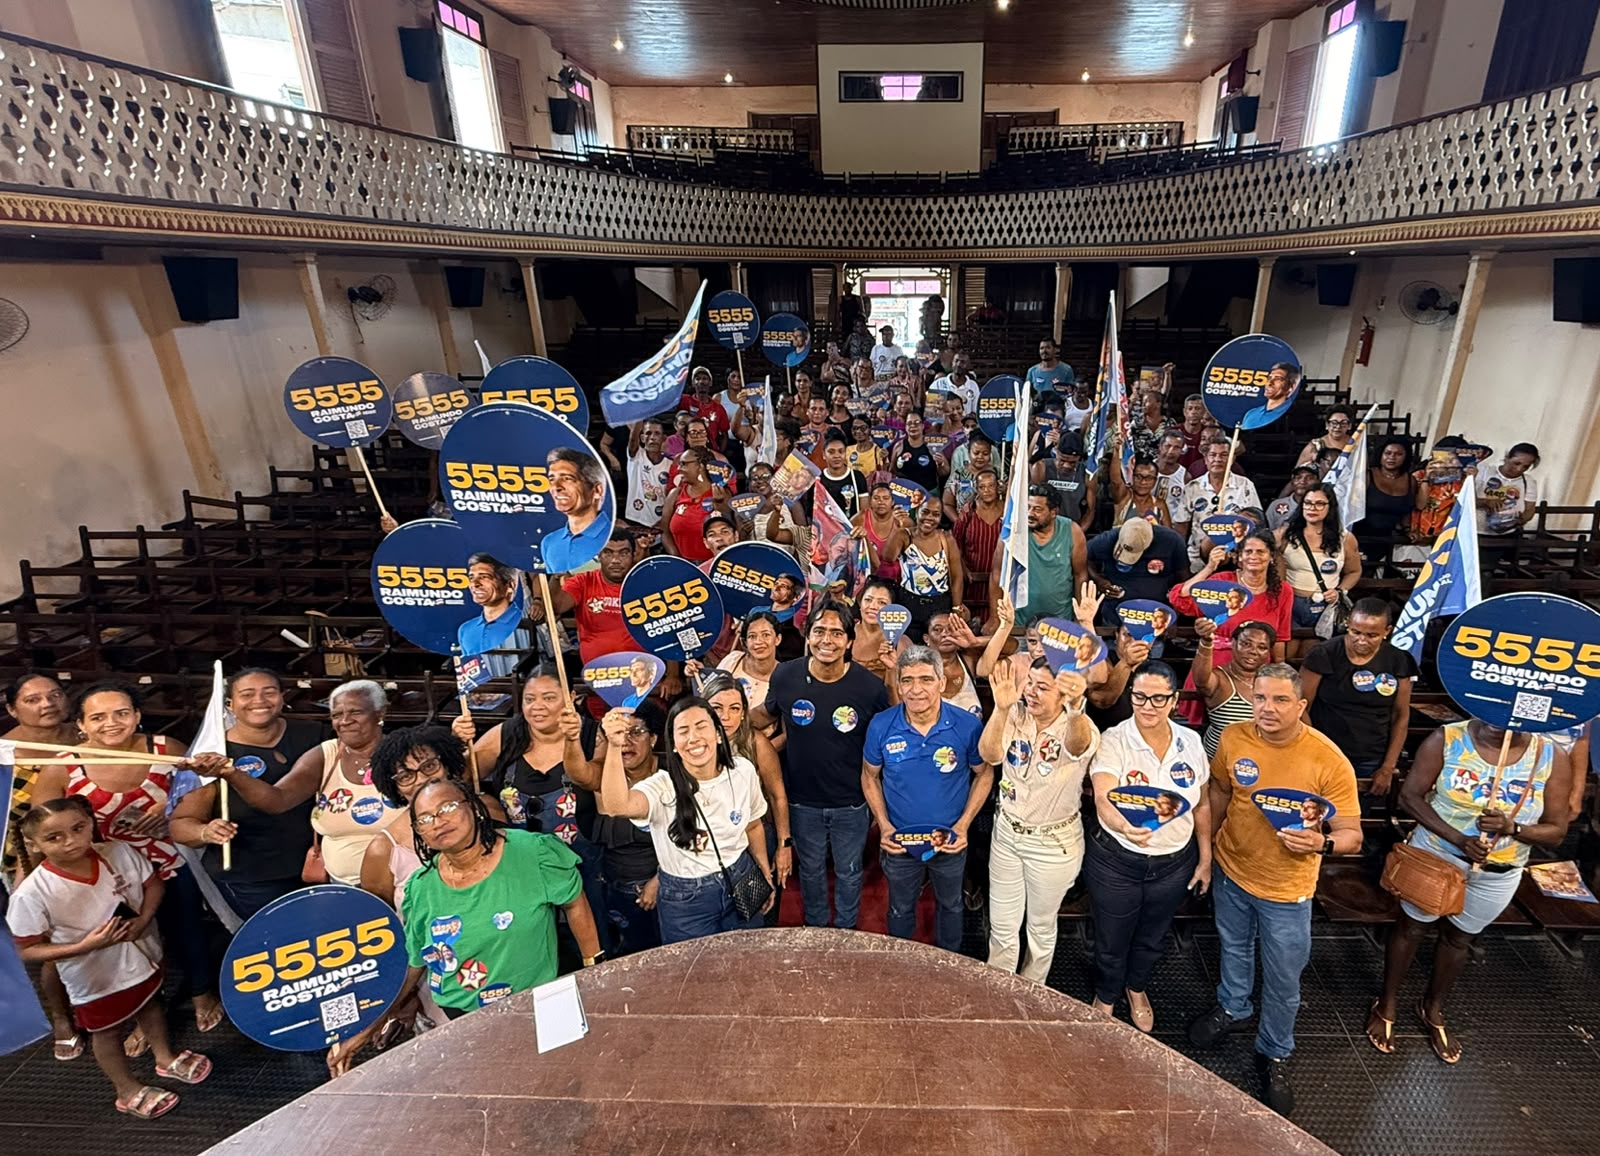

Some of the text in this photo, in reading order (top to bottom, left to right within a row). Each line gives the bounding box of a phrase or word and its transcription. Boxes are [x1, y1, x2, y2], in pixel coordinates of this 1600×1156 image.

[708, 308, 754, 323] 5555
[763, 331, 794, 340] 5555
[1209, 366, 1269, 386] 5555
[290, 380, 384, 410] 5555
[610, 374, 678, 404] COSTA
[1205, 388, 1239, 397] COSTA
[1206, 382, 1260, 392] RAIMUNDO
[310, 402, 375, 418] RAIMUNDO
[394, 390, 470, 420] 5555
[980, 398, 1016, 409] 5555
[312, 412, 355, 424] COSTA
[411, 410, 463, 424] RAIMUNDO
[414, 420, 447, 430] COSTA
[446, 462, 551, 493] 5555
[451, 490, 544, 506] RAIMUNDO
[732, 496, 761, 508] 5555
[454, 500, 511, 514] COSTA
[377, 565, 470, 588] 5555
[716, 560, 776, 588] 5555
[712, 577, 746, 592] COSTA
[713, 572, 766, 593] RAIMUNDO
[380, 588, 463, 600] RAIMUNDO
[382, 596, 433, 607] COSTA
[622, 578, 710, 625] 5555
[1191, 588, 1229, 601] 5555
[643, 606, 704, 632] RAIMUNDO
[880, 611, 908, 623] 5555
[1118, 608, 1153, 621] 5555
[646, 620, 686, 638] COSTA
[1453, 626, 1600, 678] 5555
[584, 666, 632, 681] 5555
[1470, 670, 1541, 690] COSTA
[1472, 660, 1588, 688] RAIMUNDO
[1108, 792, 1158, 807] 5555
[1255, 794, 1302, 810] 5555
[232, 916, 396, 992] 5555
[262, 958, 378, 1002] RAIMUNDO
[468, 971, 478, 980] 13
[265, 983, 338, 1012] COSTA
